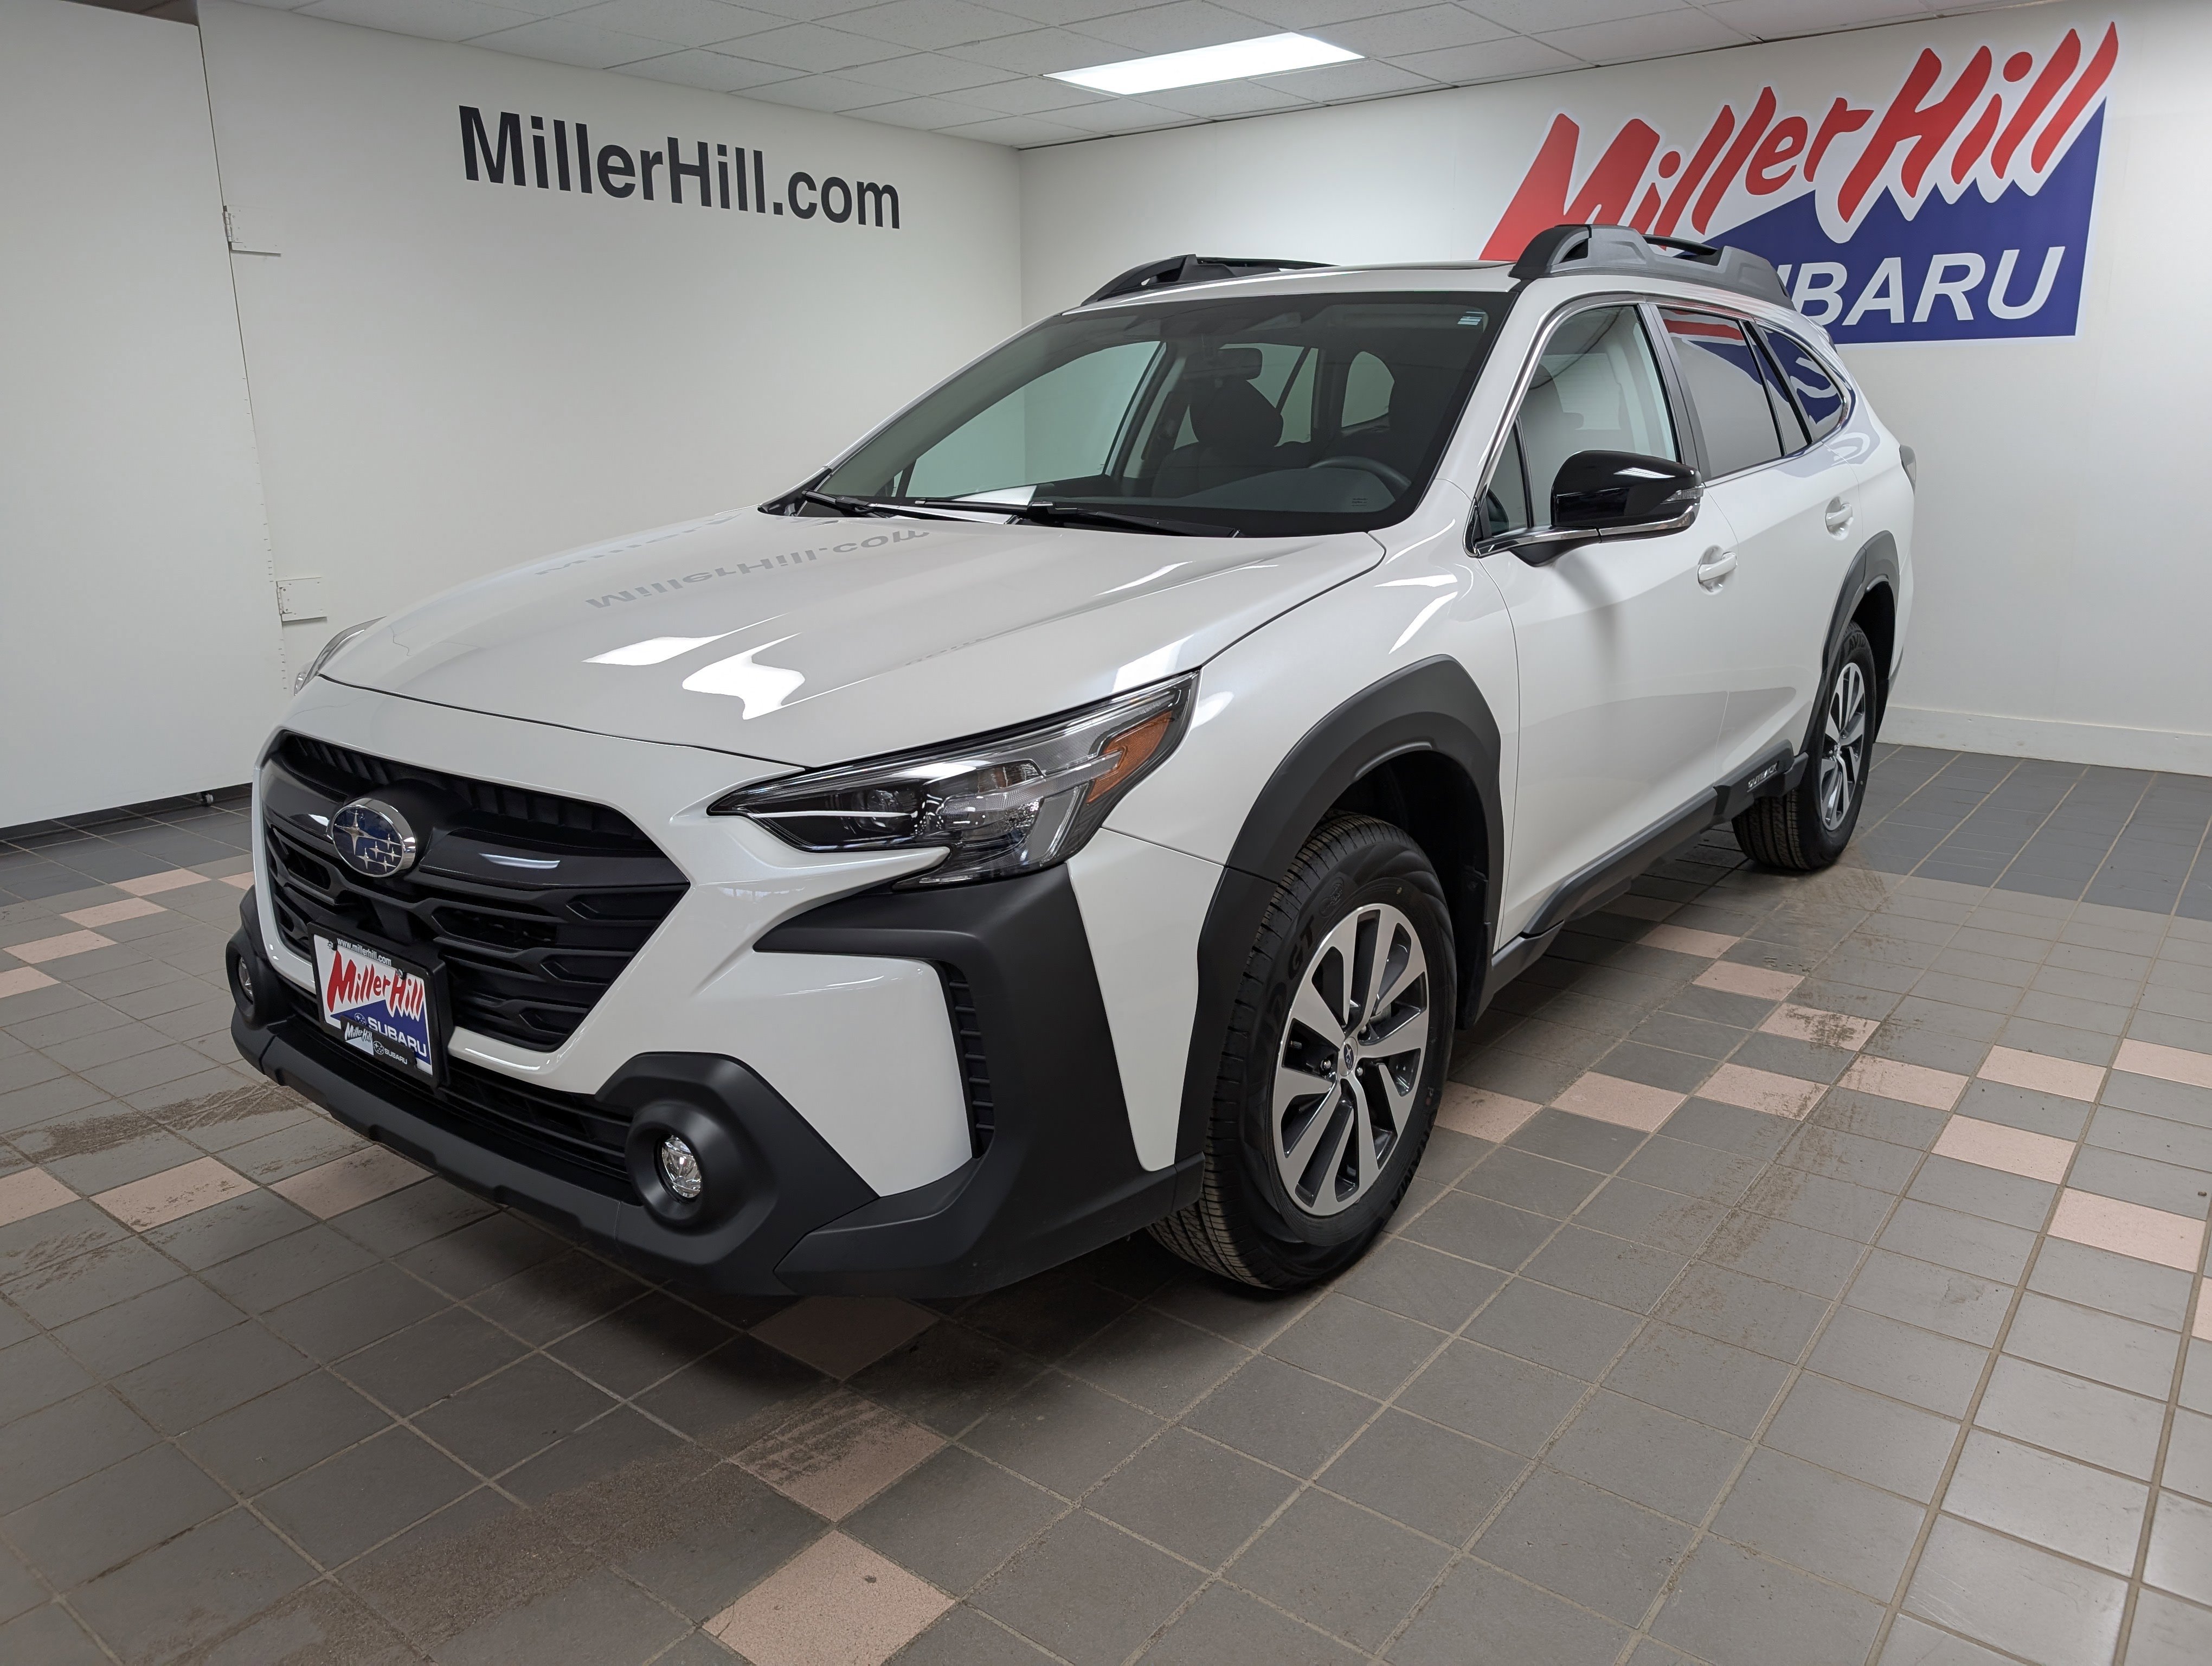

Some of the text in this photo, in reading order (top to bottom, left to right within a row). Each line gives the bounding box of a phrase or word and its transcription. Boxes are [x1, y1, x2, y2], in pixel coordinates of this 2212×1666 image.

[459, 105, 900, 229] MillerHill.com
[1776, 246, 2066, 326] BARU
[337, 938, 392, 966] www.millerhill.com
[368, 1016, 427, 1057] SUBARU
[384, 1047, 408, 1065] SUBARU
